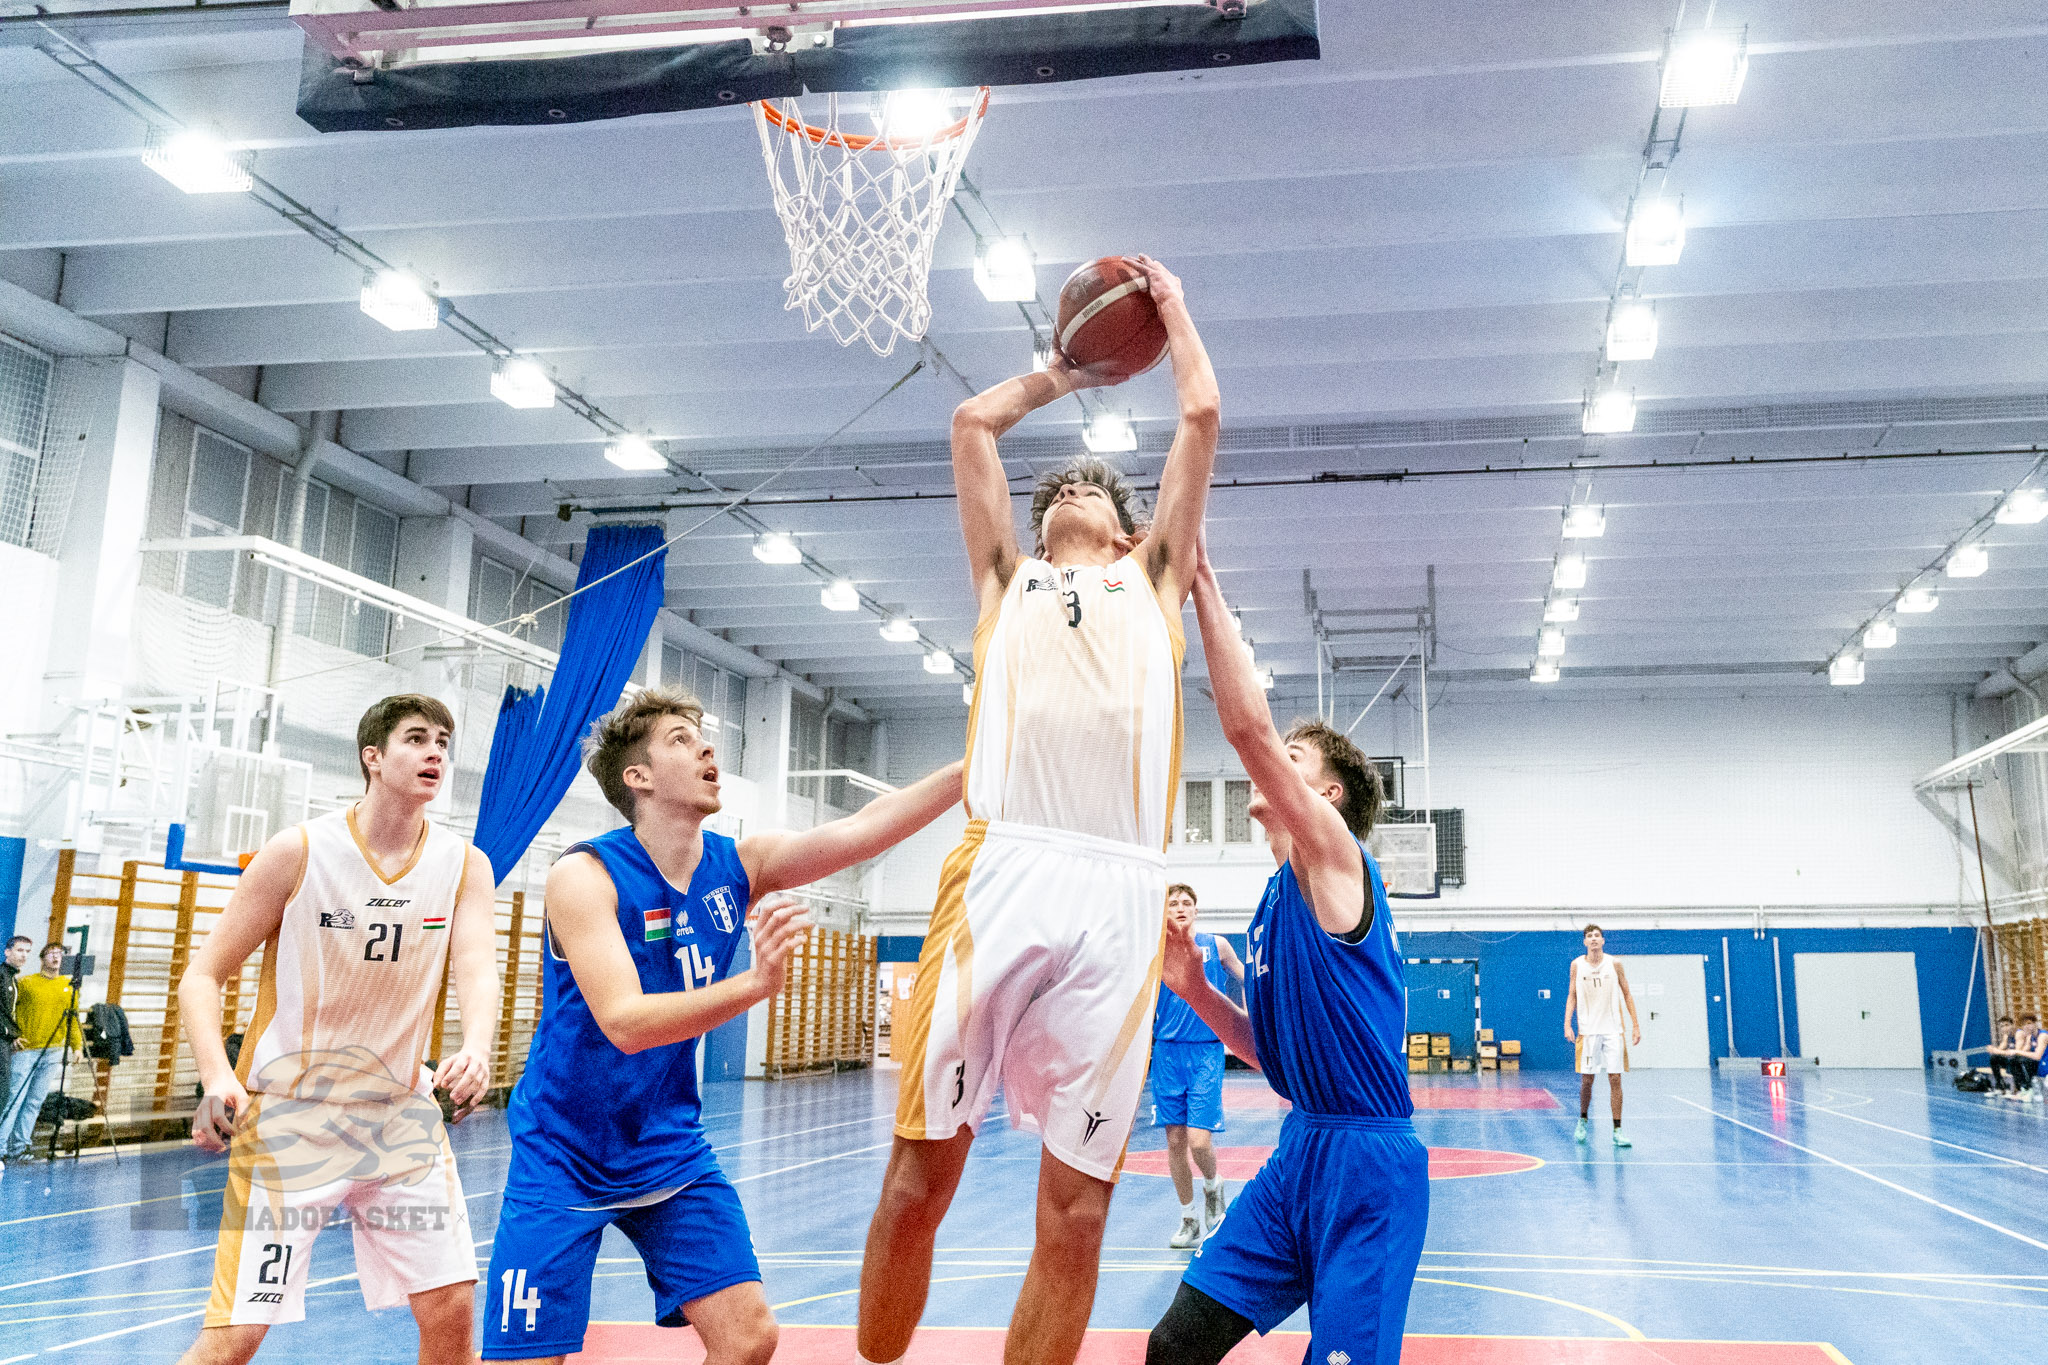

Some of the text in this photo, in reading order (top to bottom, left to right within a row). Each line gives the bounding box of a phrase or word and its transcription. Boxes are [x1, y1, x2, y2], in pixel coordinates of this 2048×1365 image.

[1062, 590, 1082, 628] 3
[364, 923, 403, 962] 21
[676, 926, 695, 936] errea
[674, 944, 715, 992] 14
[952, 1060, 965, 1110] 3
[1768, 1062, 1784, 1077] 17
[259, 1243, 292, 1286] 21
[501, 1269, 541, 1333] 14
